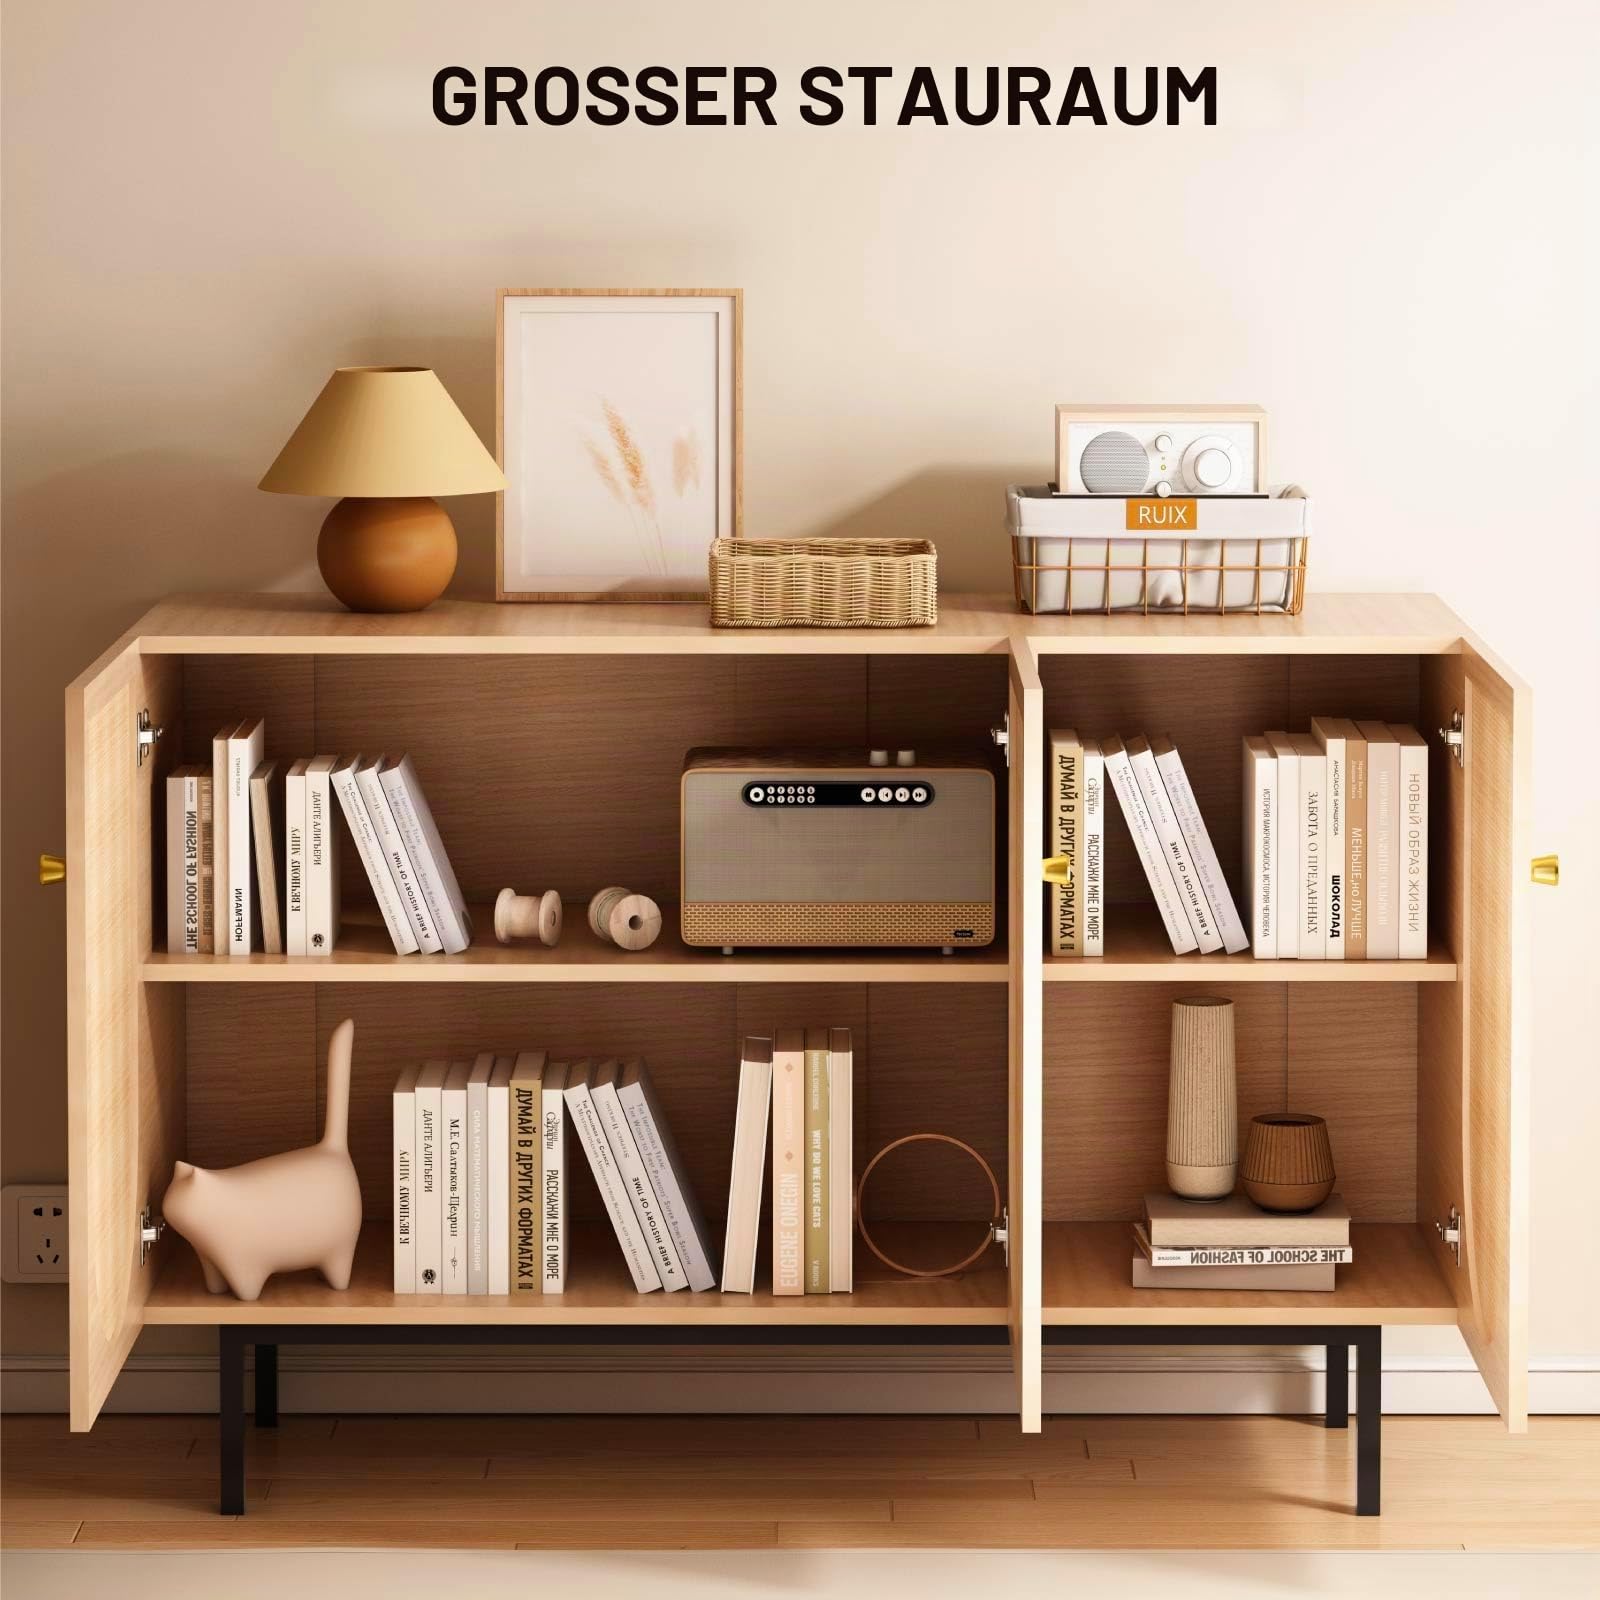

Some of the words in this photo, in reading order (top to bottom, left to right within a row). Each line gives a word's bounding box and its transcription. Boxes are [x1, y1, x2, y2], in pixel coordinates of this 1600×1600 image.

[1139, 506, 1187, 524] RUIX
[1059, 755, 1078, 800] ДУМАЙ
[312, 791, 321, 820] ДАНТЕ
[1061, 805, 1074, 813] В
[1408, 773, 1422, 825] НОВЫЙ
[1308, 791, 1318, 837] ЗАБОТА
[291, 827, 300, 856] МИРУ
[1169, 841, 1181, 859] TIME
[1308, 842, 1318, 852] О
[1408, 830, 1419, 875] ОБРАЗ
[392, 851, 403, 868] TIME
[1087, 834, 1099, 882] РАССКАЖИ
[1177, 861, 1186, 872] OF
[291, 859, 300, 904] ВЕЧНОМУ
[399, 869, 407, 880] OF
[403, 881, 419, 911] HISTORY
[1087, 885, 1099, 904] МНЕ
[1181, 873, 1199, 906] HISTORY
[1306, 856, 1318, 934] ПРЕДАННЫХ
[1060, 871, 1075, 939] ОРМАТАХ
[1194, 906, 1207, 928] BRIEF
[1330, 875, 1340, 939] ШОКОЛАД
[1351, 899, 1362, 939] ЛУЧШЕ
[1408, 880, 1419, 932] ЖИЗНИ
[415, 912, 427, 931] BRIEF
[1087, 916, 1099, 940] МОРЕ
[423, 1109, 433, 1141] ДАНТЕ
[473, 1110, 481, 1134] СИЛА
[515, 1088, 536, 1135] ДУМАЙ
[813, 1129, 821, 1150] WHY
[399, 1150, 410, 1181] МИРУ
[813, 1152, 821, 1164] DO
[473, 1136, 481, 1220] МАТЕМАТИЧЕСКОГО
[516, 1152, 533, 1203] ДРУГИХ
[632, 1176, 644, 1195] TIME
[813, 1167, 821, 1181] WE
[546, 1169, 558, 1219] РАССКАЖИ
[639, 1196, 649, 1209] OF
[780, 1174, 799, 1226] ONEGIN
[813, 1182, 821, 1204] LOVE
[399, 1186, 410, 1235] ВЕЧНОМУ
[813, 1206, 821, 1228] CATS
[546, 1222, 558, 1242] МНЕ
[645, 1209, 662, 1243] HISTORY
[399, 1237, 410, 1245] К
[473, 1221, 481, 1272] МЫШЛЕНИЯ
[518, 1207, 533, 1277] ФОРМАТАХ
[658, 1244, 671, 1266] BRIEF
[546, 1254, 558, 1279] МОРЕ
[667, 1267, 675, 1275] A
[780, 1232, 799, 1287] EUGENE
